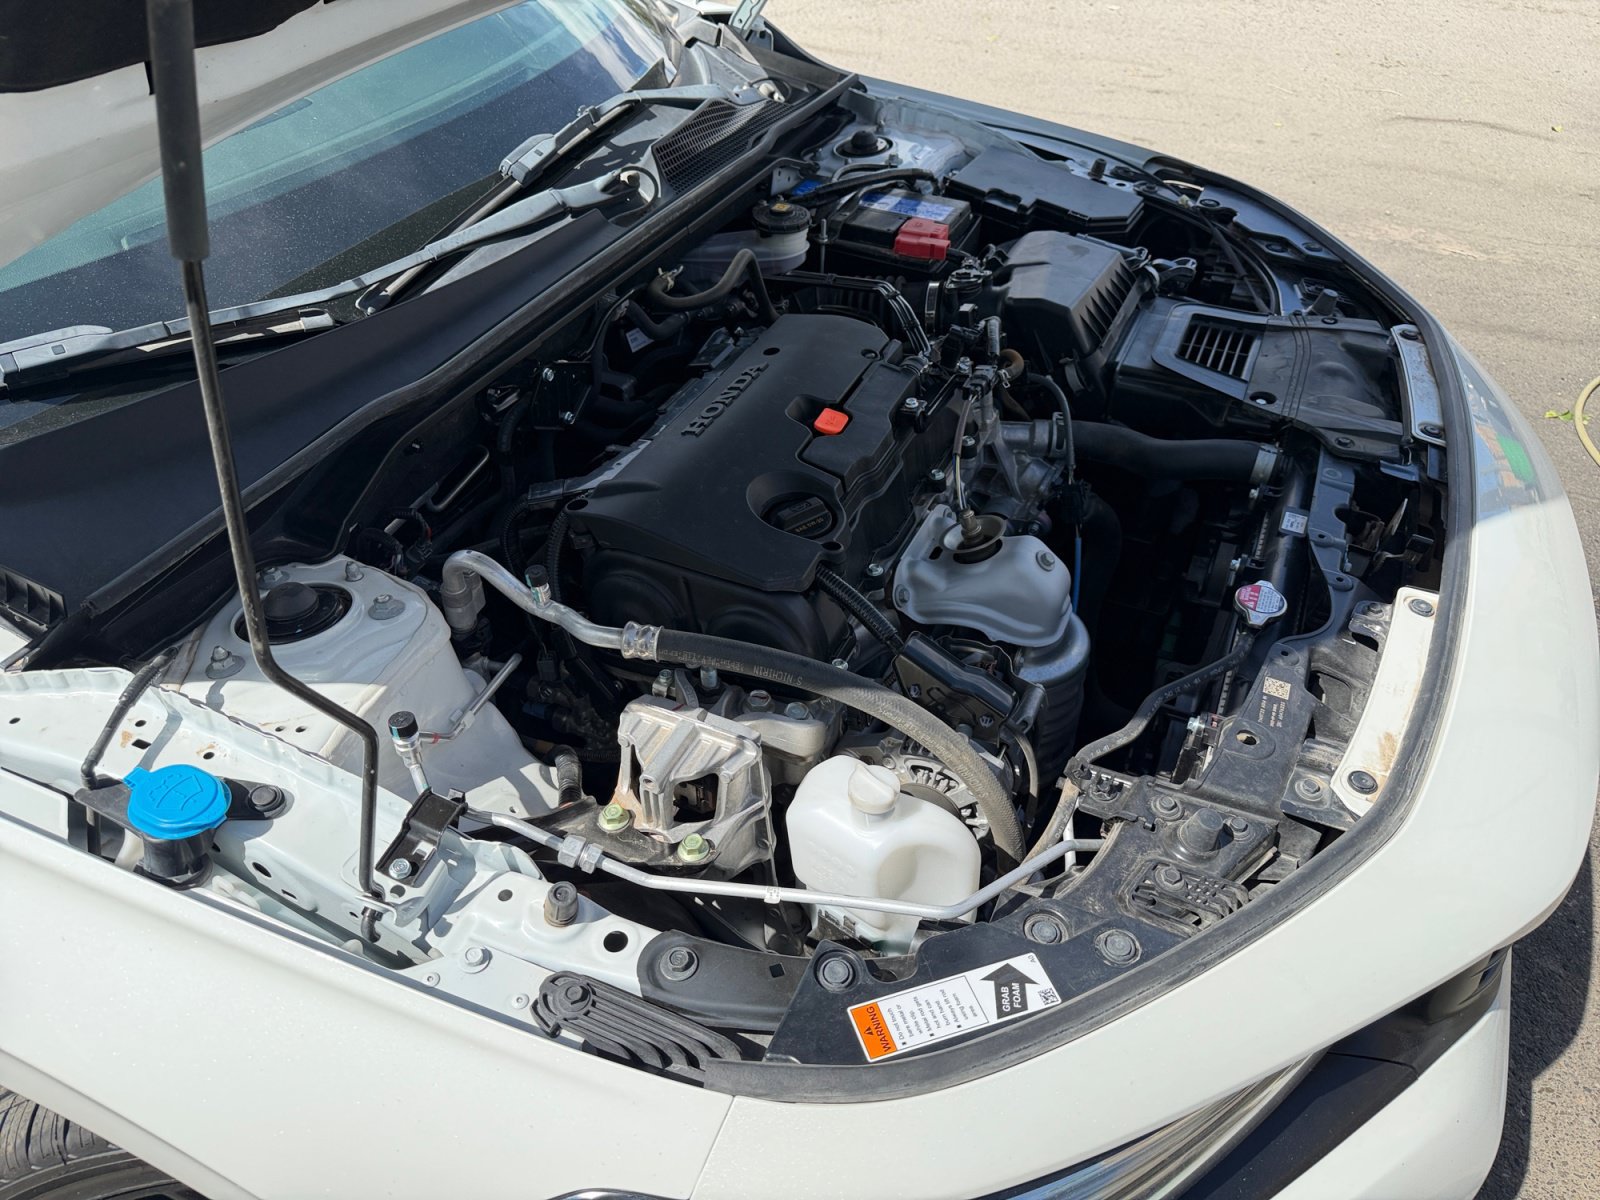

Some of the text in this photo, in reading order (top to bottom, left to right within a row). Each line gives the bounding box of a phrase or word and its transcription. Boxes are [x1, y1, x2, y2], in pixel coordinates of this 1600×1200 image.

[681, 362, 769, 437] HONDA
[1001, 986, 1011, 1012] GRAB
[1012, 982, 1021, 1008] FOAM
[866, 1006, 891, 1052] WARNING
